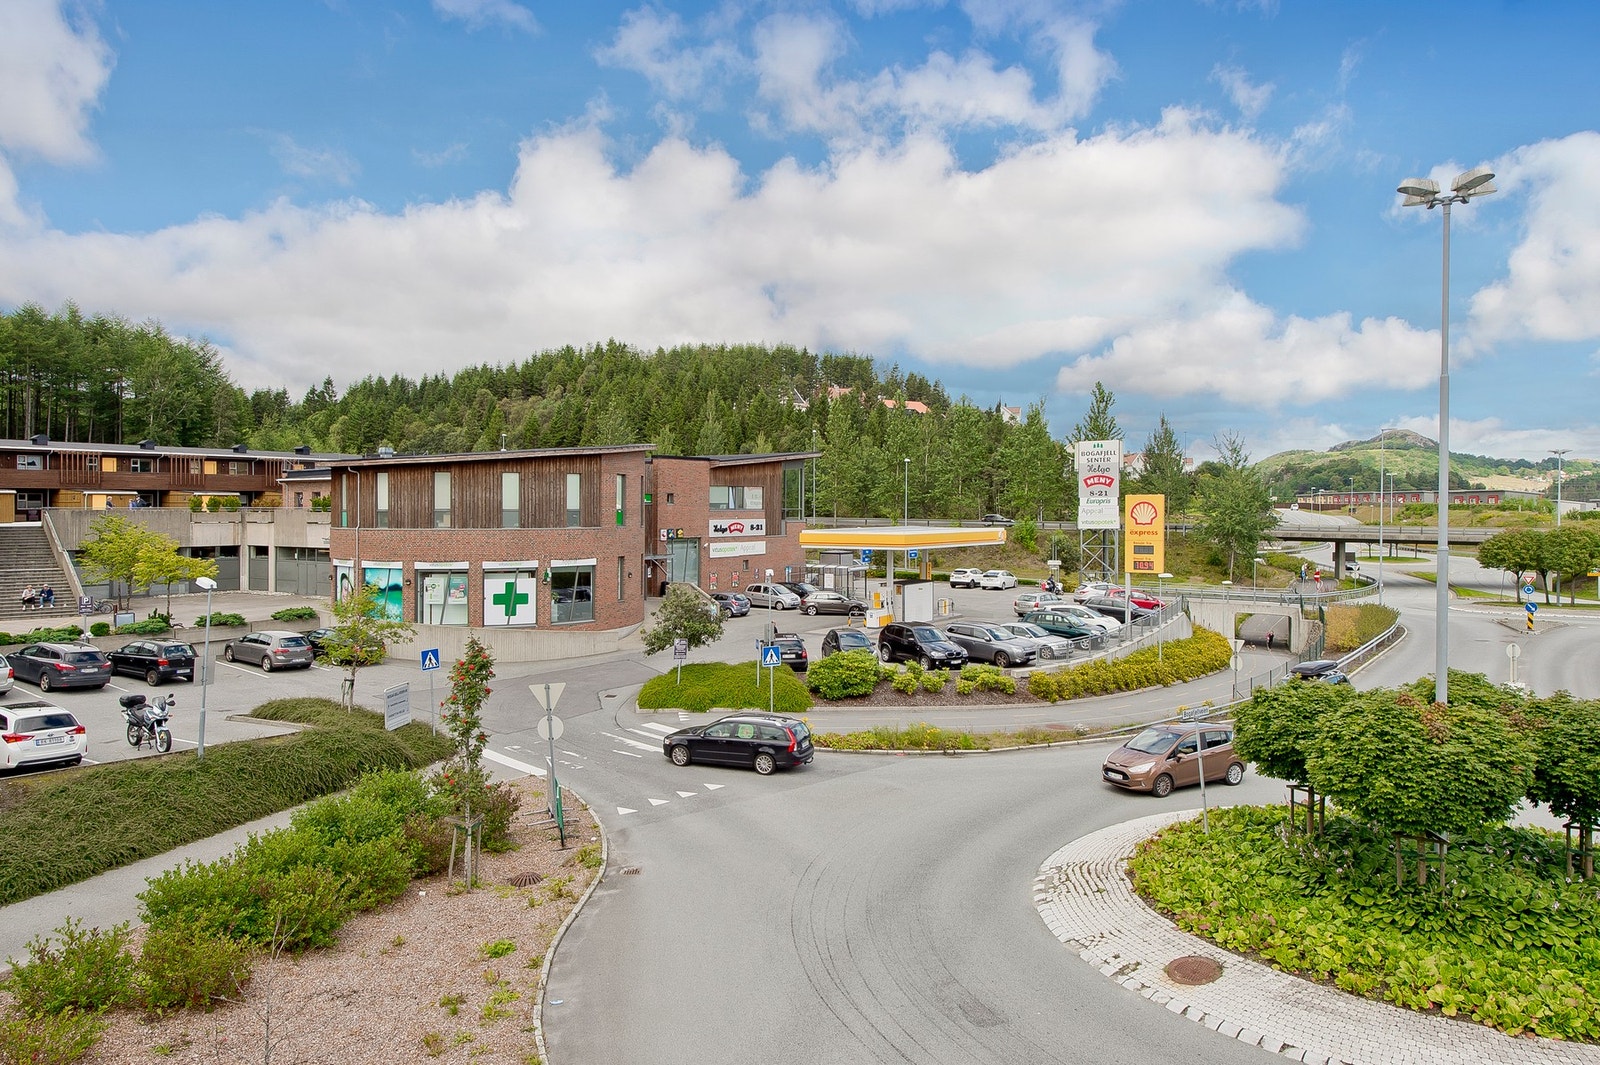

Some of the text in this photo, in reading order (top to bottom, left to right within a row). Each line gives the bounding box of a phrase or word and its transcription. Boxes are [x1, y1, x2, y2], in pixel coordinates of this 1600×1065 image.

[1087, 464, 1111, 474] Helgo
[1086, 476, 1112, 485] MENY
[1086, 498, 1111, 506] Europris
[1130, 529, 1158, 537] express
